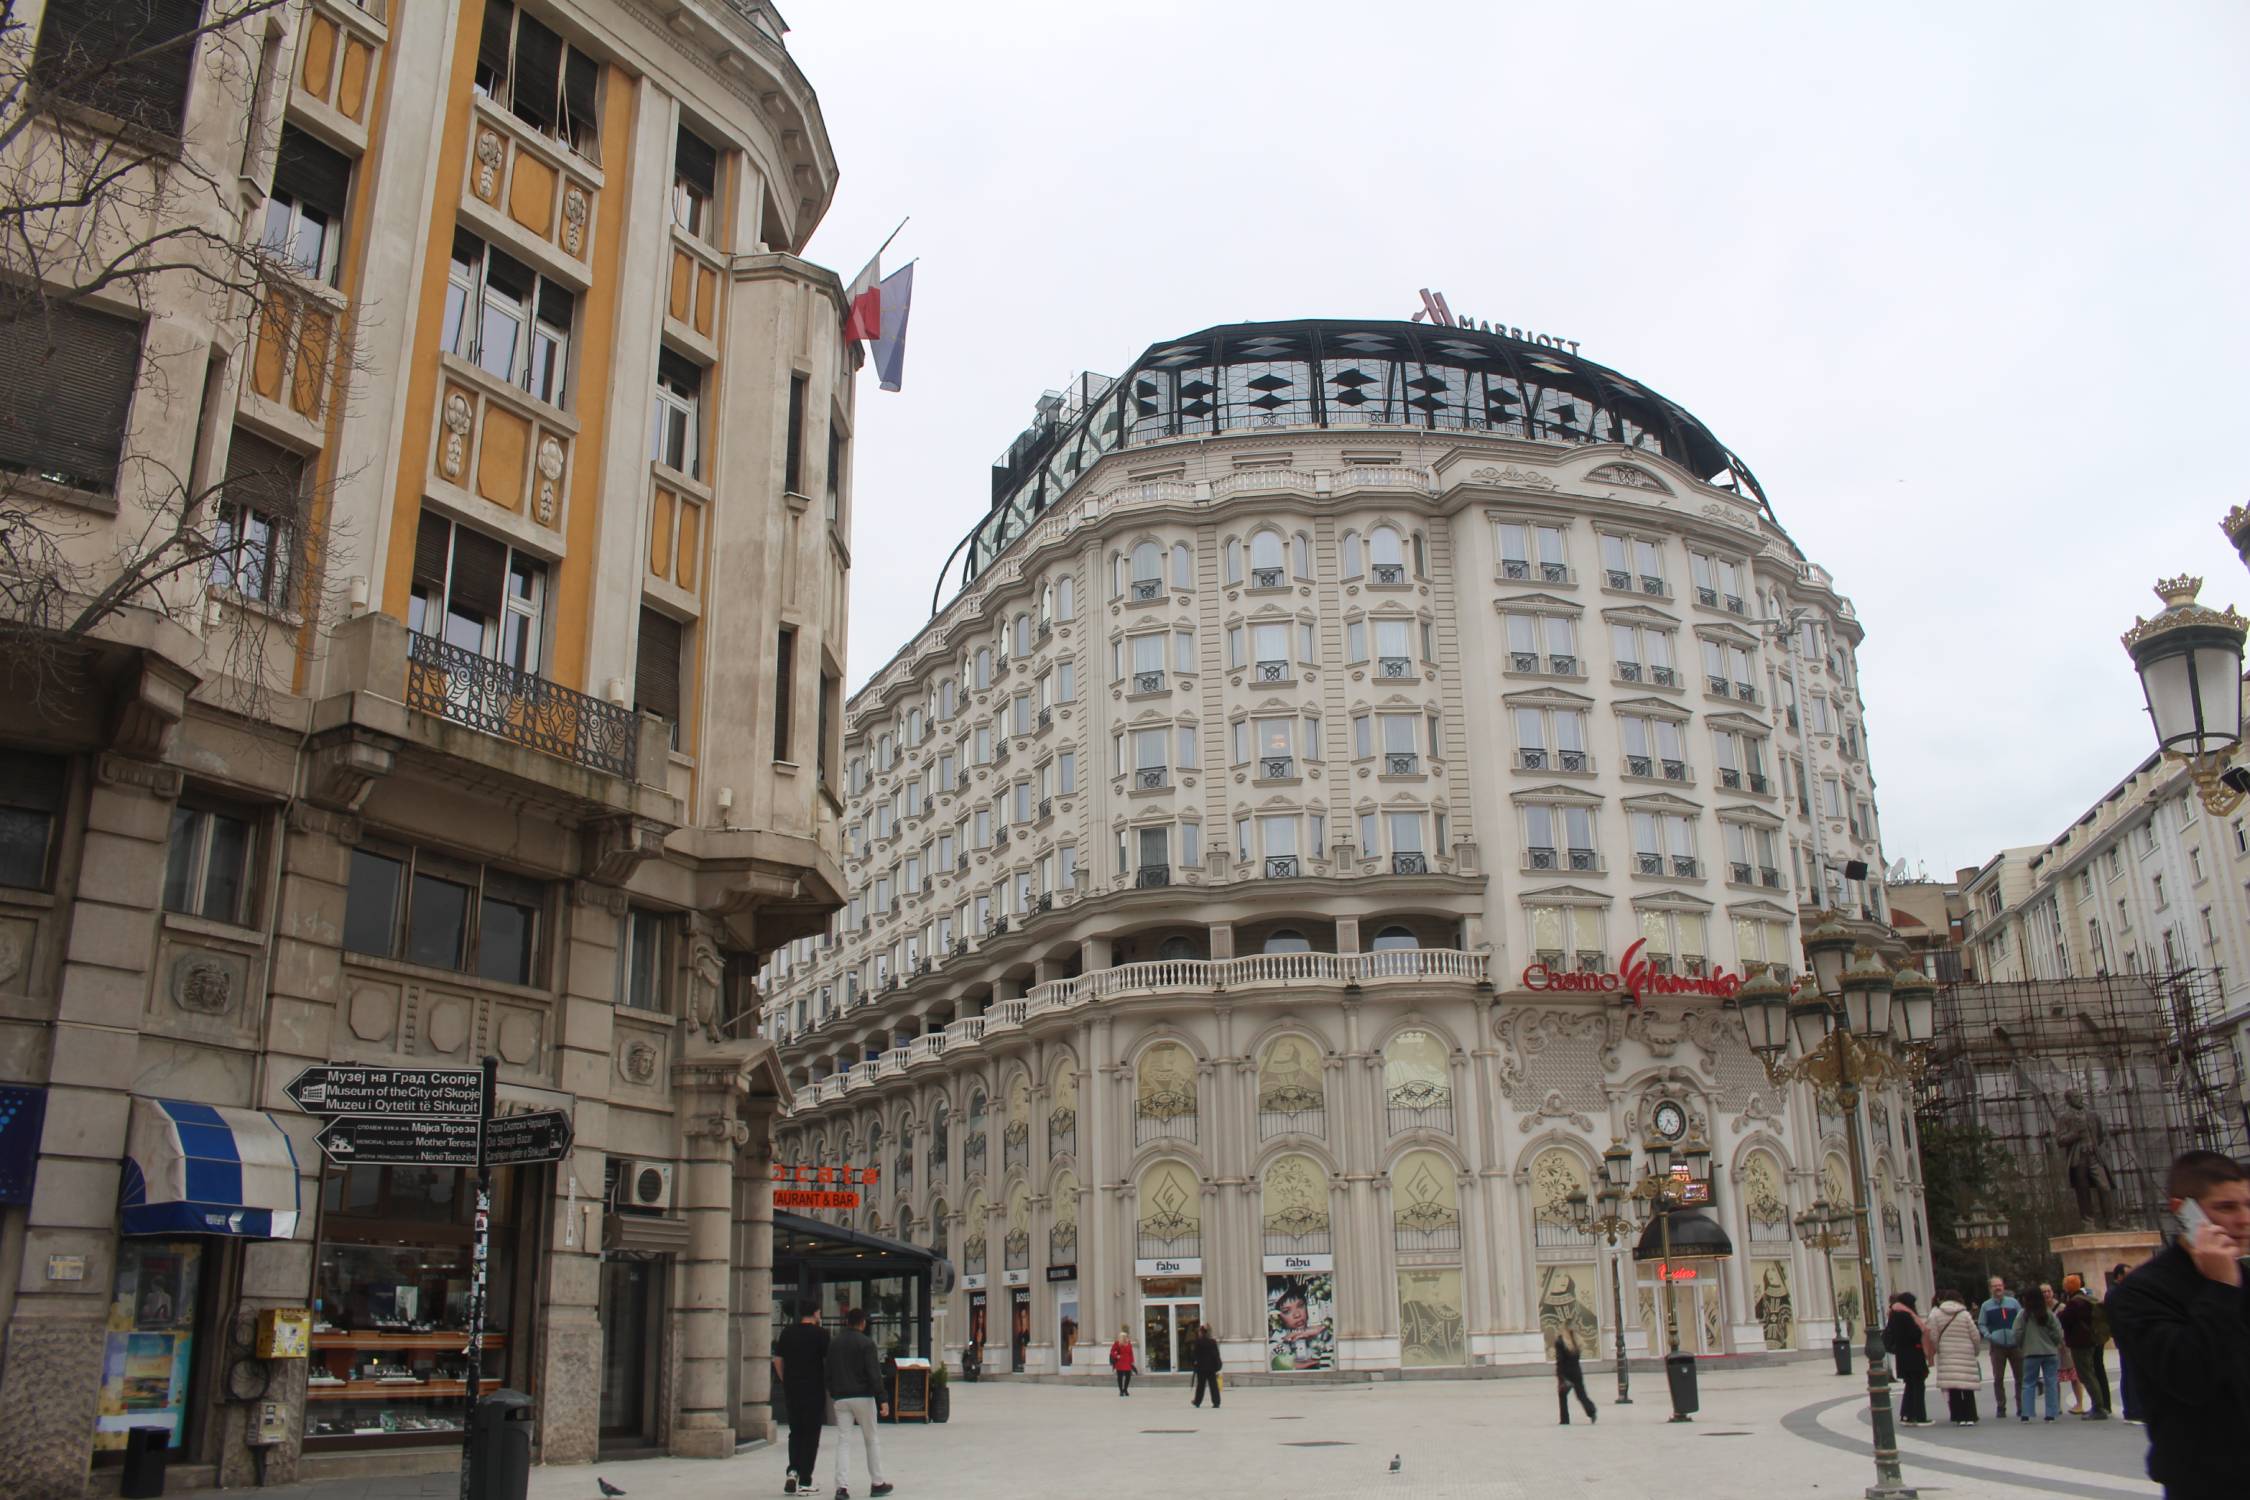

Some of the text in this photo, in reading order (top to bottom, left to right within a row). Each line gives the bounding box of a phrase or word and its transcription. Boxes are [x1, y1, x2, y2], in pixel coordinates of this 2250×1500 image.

[1459, 314, 1581, 358] MARRIOTT
[1523, 963, 1619, 993] Casino
[327, 1070, 478, 1087] Музеј на Град Скопје
[326, 1085, 481, 1101] Museum of the City of Skopje
[326, 1098, 478, 1114] Muzeu i Qytetit të Shkupit
[411, 1122, 440, 1134] Мајка
[440, 1123, 477, 1135] Тереза
[415, 1137, 448, 1148] Mother
[447, 1137, 477, 1148] Teresa
[832, 1194, 854, 1208] BAR
[1156, 1260, 1180, 1271] fabu
[1285, 1257, 1311, 1268] fabu
[1657, 1263, 1697, 1280] Csino
[1016, 1292, 1030, 1303] BOSS
